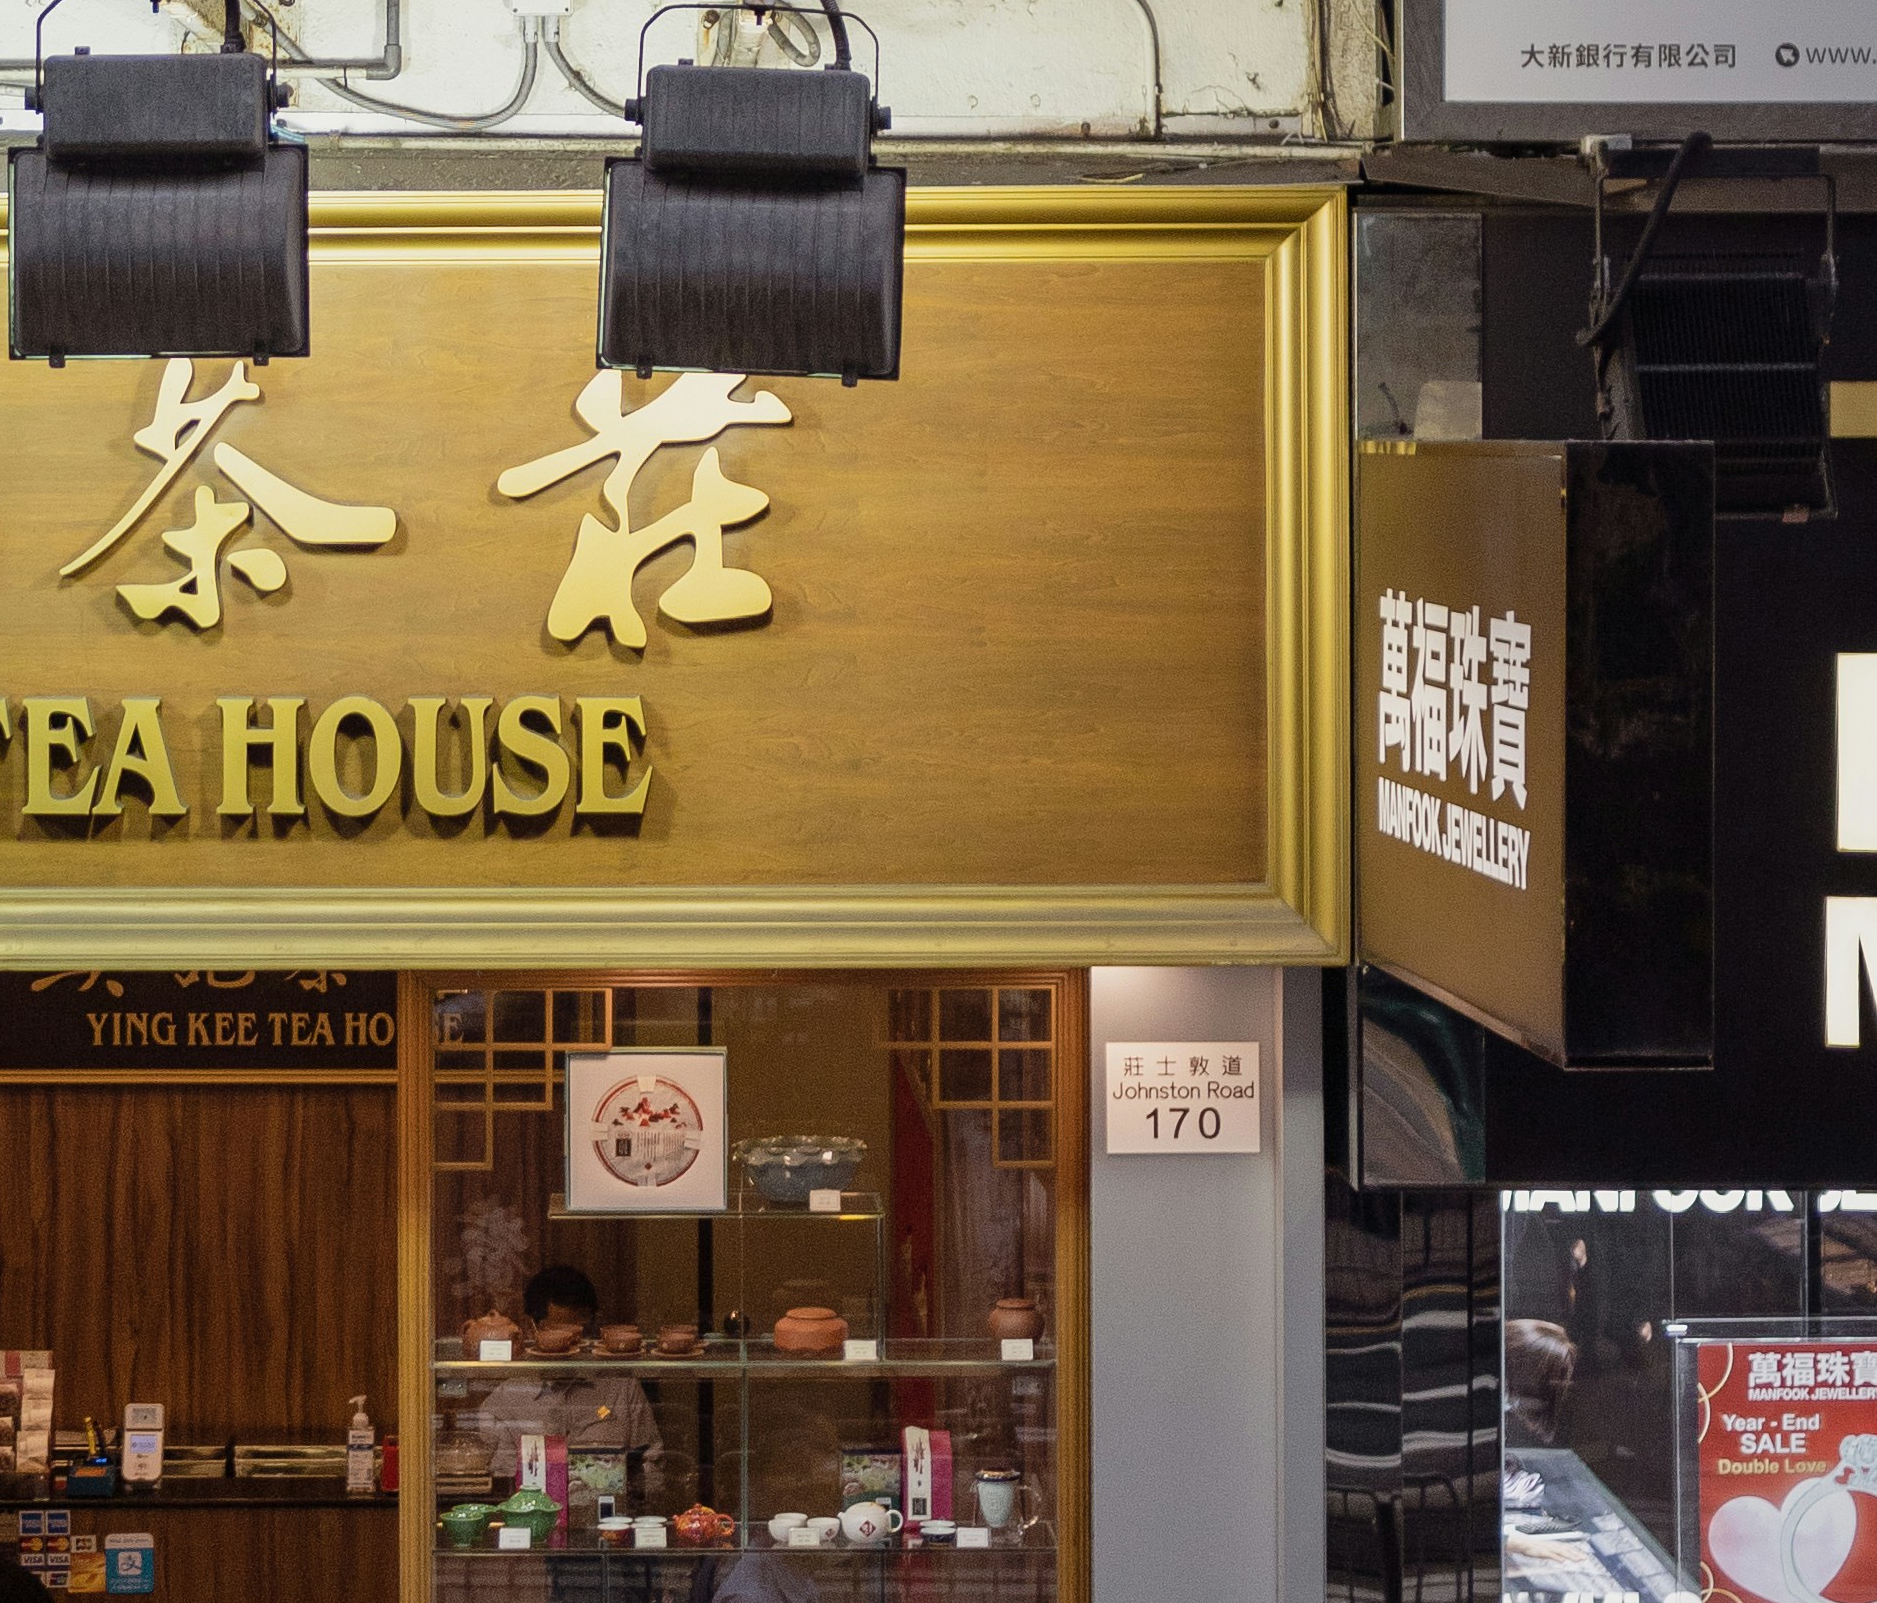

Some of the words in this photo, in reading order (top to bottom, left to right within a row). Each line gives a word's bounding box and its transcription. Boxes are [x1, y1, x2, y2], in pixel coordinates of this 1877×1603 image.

[1521, 43, 1737, 69] 大新銀行有限公司
[1377, 587, 1532, 811] 萬福珠寶
[215, 694, 654, 818] HOUSE
[1378, 776, 1443, 858] MANFOOK
[1442, 801, 1531, 891] JEWELLERY
[86, 1011, 177, 1047] YING
[187, 1011, 259, 1047] KEE
[267, 1011, 336, 1047] TEA
[1123, 1054, 1244, 1077] 莊士敦道
[1112, 1080, 1201, 1100] Johnston
[1207, 1080, 1255, 1099] Road
[1145, 1106, 1222, 1140] 170
[1747, 1350, 1877, 1388] 萬福珠寶
[1748, 1387, 1810, 1401] MANFOOK
[1722, 1413, 1766, 1431] Year
[1781, 1413, 1821, 1431] End
[1740, 1432, 1807, 1455] SALE
[1717, 1458, 1780, 1475] Double
[1784, 1458, 1827, 1474] Love
